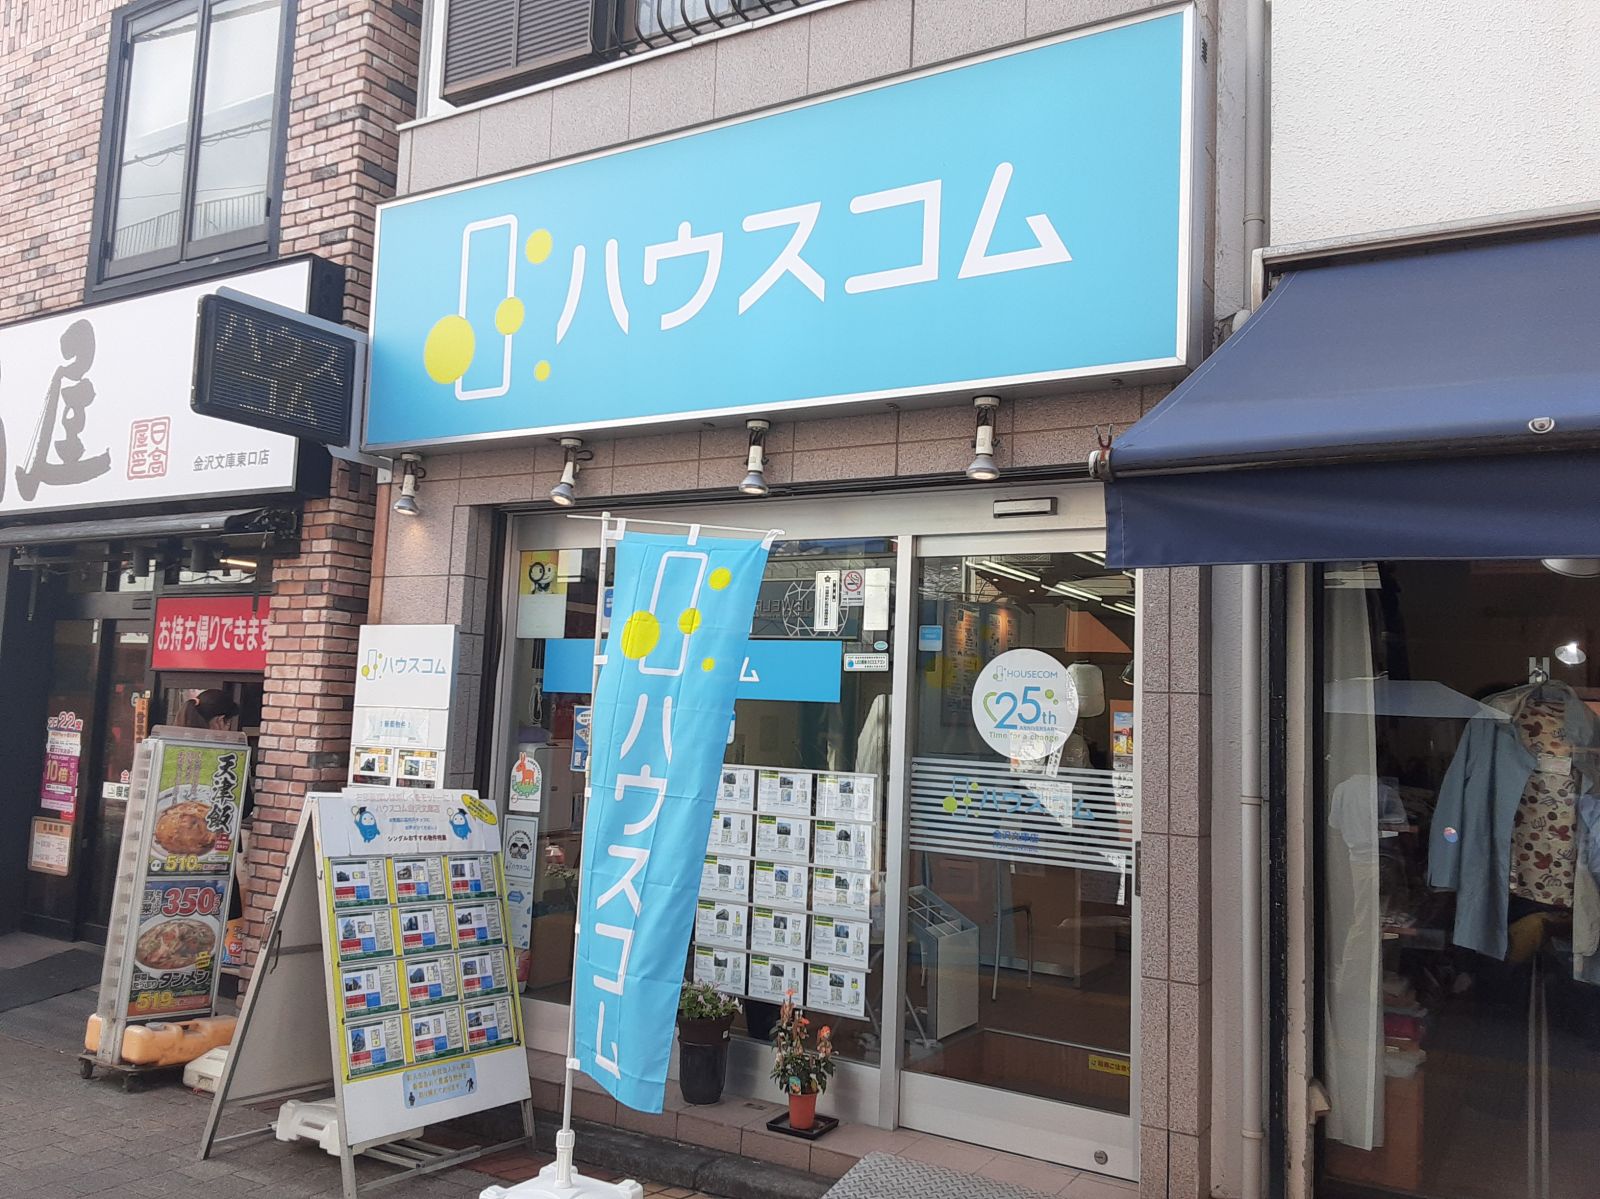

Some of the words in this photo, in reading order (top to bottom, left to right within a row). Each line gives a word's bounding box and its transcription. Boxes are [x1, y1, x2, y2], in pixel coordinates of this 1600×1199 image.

[556, 161, 1073, 346] ハウスコム
[216, 313, 344, 386] ハウス
[239, 370, 319, 426] コム
[193, 449, 270, 472] 金沢文庫東口店
[157, 615, 271, 651] お持ち帰りできます
[382, 657, 447, 675] ハウスコム
[1007, 670, 1058, 679] HOUSECOM
[994, 686, 1057, 730] 25th
[989, 731, 1008, 739] Time
[207, 754, 238, 832] 天津飯
[162, 887, 216, 917] 350
[593, 693, 673, 1081] ハウスコム
[159, 971, 209, 988] タンメン
